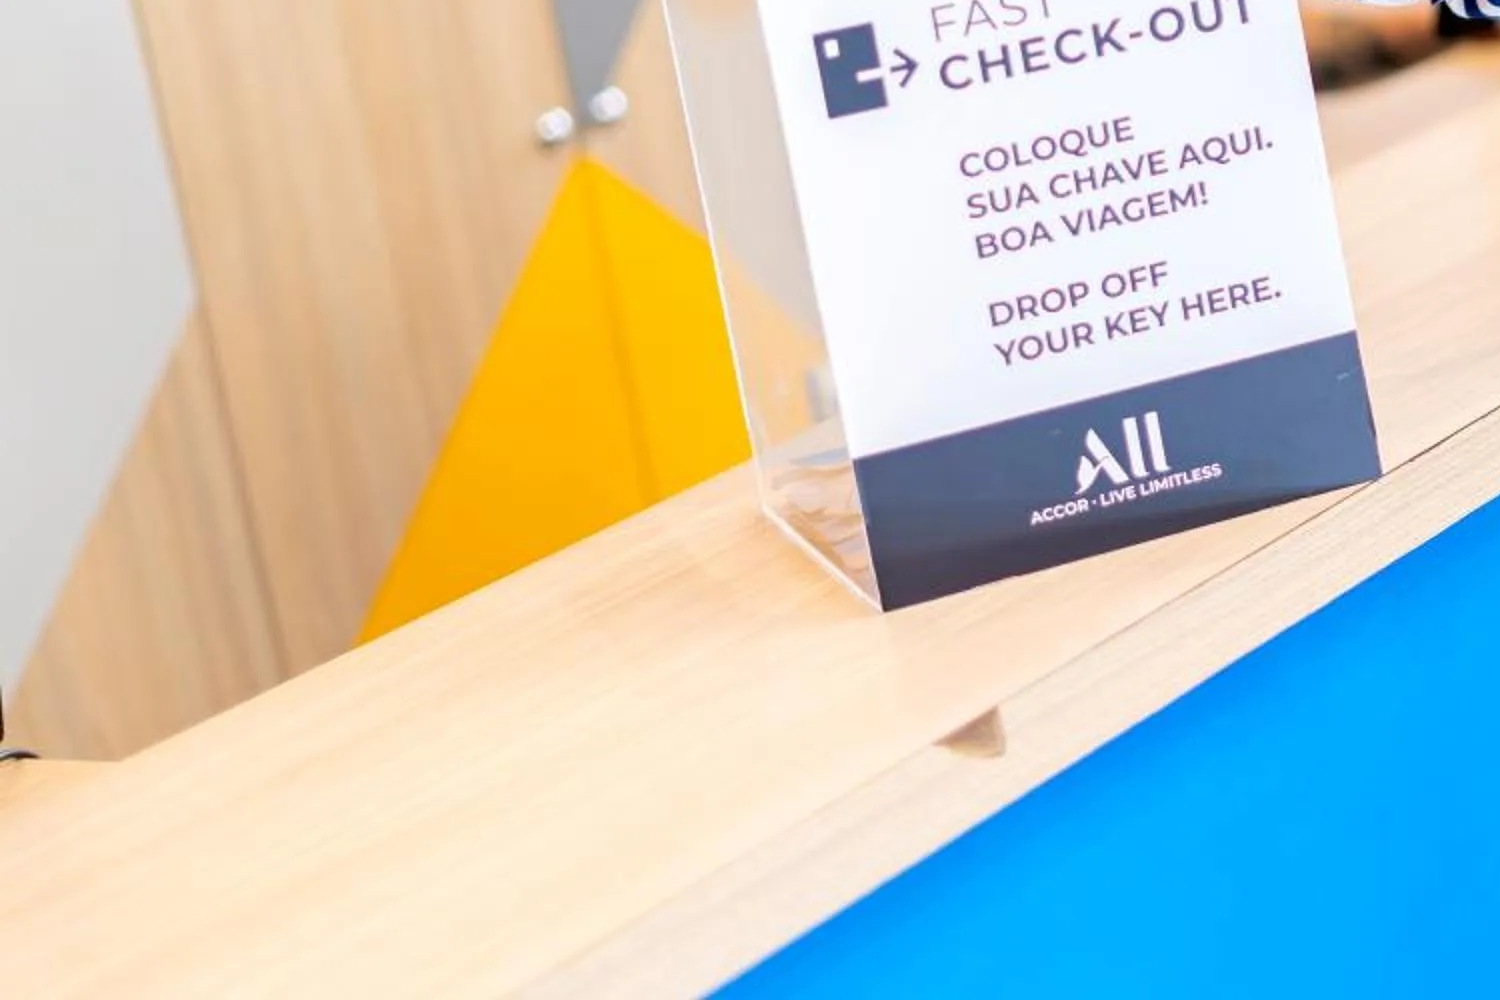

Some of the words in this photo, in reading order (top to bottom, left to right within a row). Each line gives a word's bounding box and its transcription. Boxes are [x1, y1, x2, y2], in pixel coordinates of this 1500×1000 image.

[960, 117, 1135, 178] COLOQUE
[967, 184, 1039, 219] SUA
[1049, 150, 1169, 200] CHAVE
[1178, 127, 1273, 170] AQUI.
[976, 221, 1053, 260] BOA
[1061, 182, 1208, 238] VIAGEM!
[989, 280, 1091, 327] DROP
[1101, 262, 1169, 298] OFF
[994, 322, 1095, 367] YOUR
[1105, 302, 1169, 340] KEY
[1181, 276, 1282, 321] HERE.
[1030, 498, 1090, 526] ACCOR
[1100, 485, 1137, 508] LIVE
[1139, 463, 1223, 496] LIMITLESS
